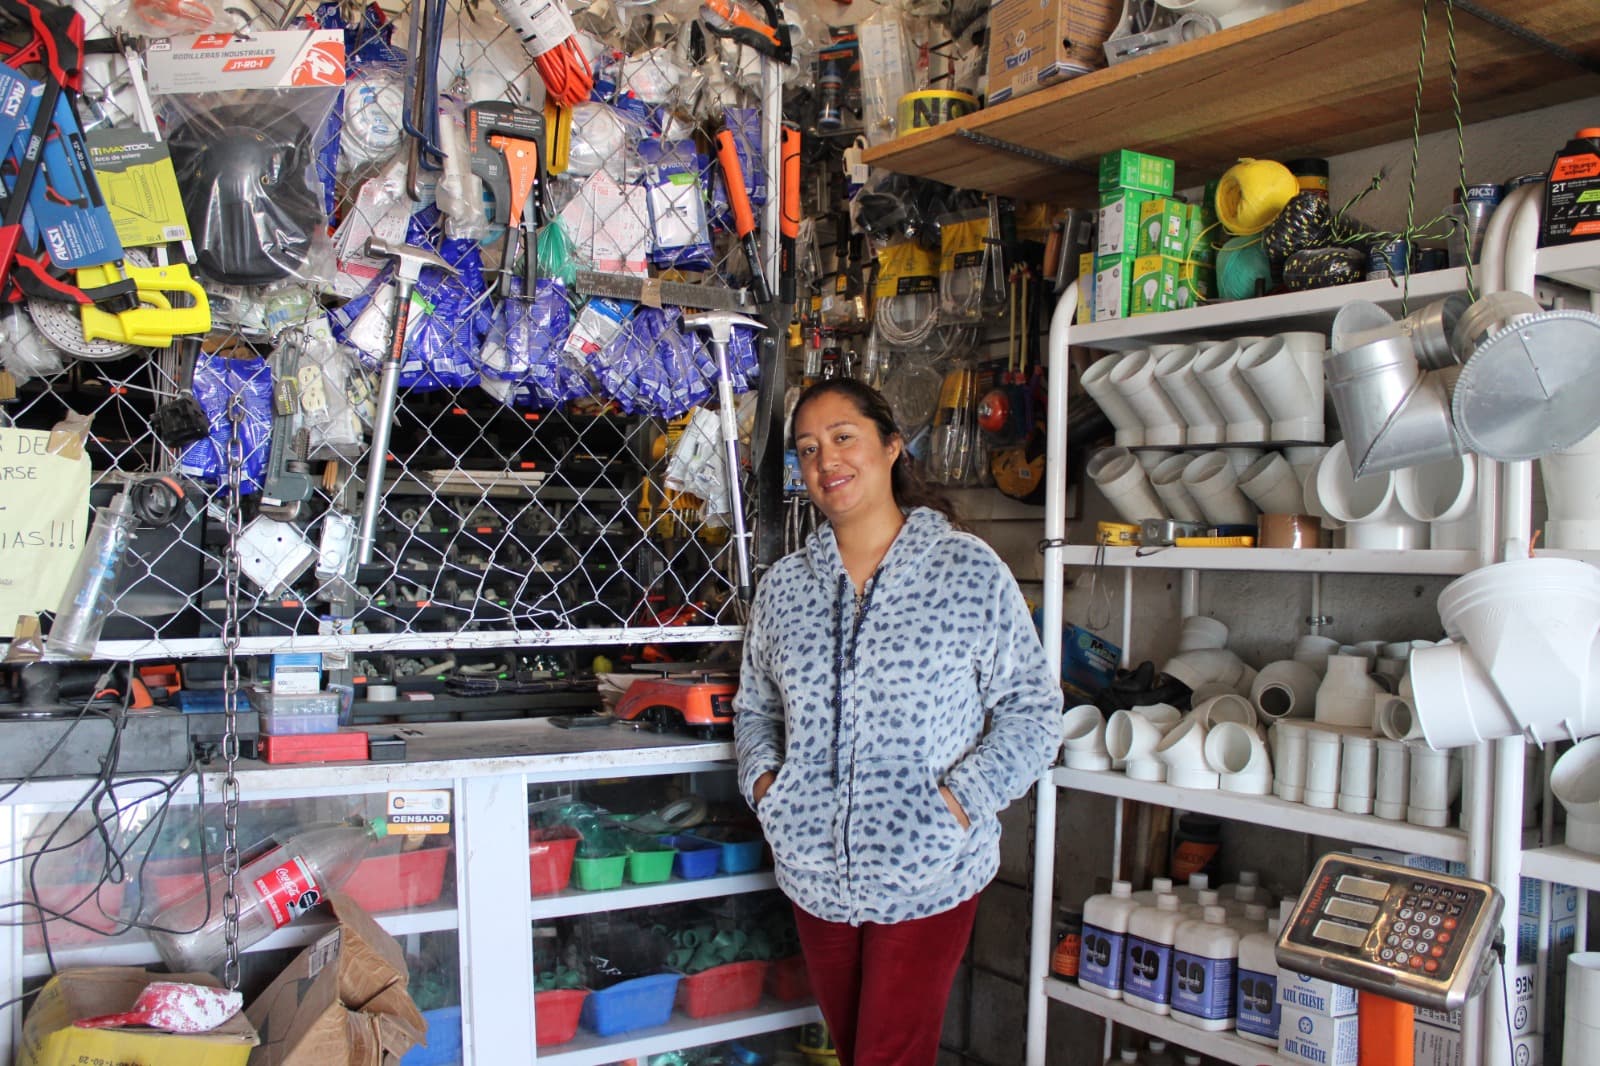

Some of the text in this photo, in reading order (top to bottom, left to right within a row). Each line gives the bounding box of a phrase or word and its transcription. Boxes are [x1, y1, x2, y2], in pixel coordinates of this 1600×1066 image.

[172, 48, 276, 60] RODILLERAS INDUSTRIALES
[5, 80, 26, 117] AKSI
[104, 143, 155, 154] MAXTOOL
[1467, 187, 1495, 198] AKSI
[1551, 183, 1567, 193] 2T
[48, 227, 69, 261] AKSI
[0, 466, 37, 480] RSE
[392, 815, 445, 823] CENSADO
[1282, 988, 1325, 1011] AZUL CELESTE
[1284, 1038, 1327, 1064] AZUL CELESTE
